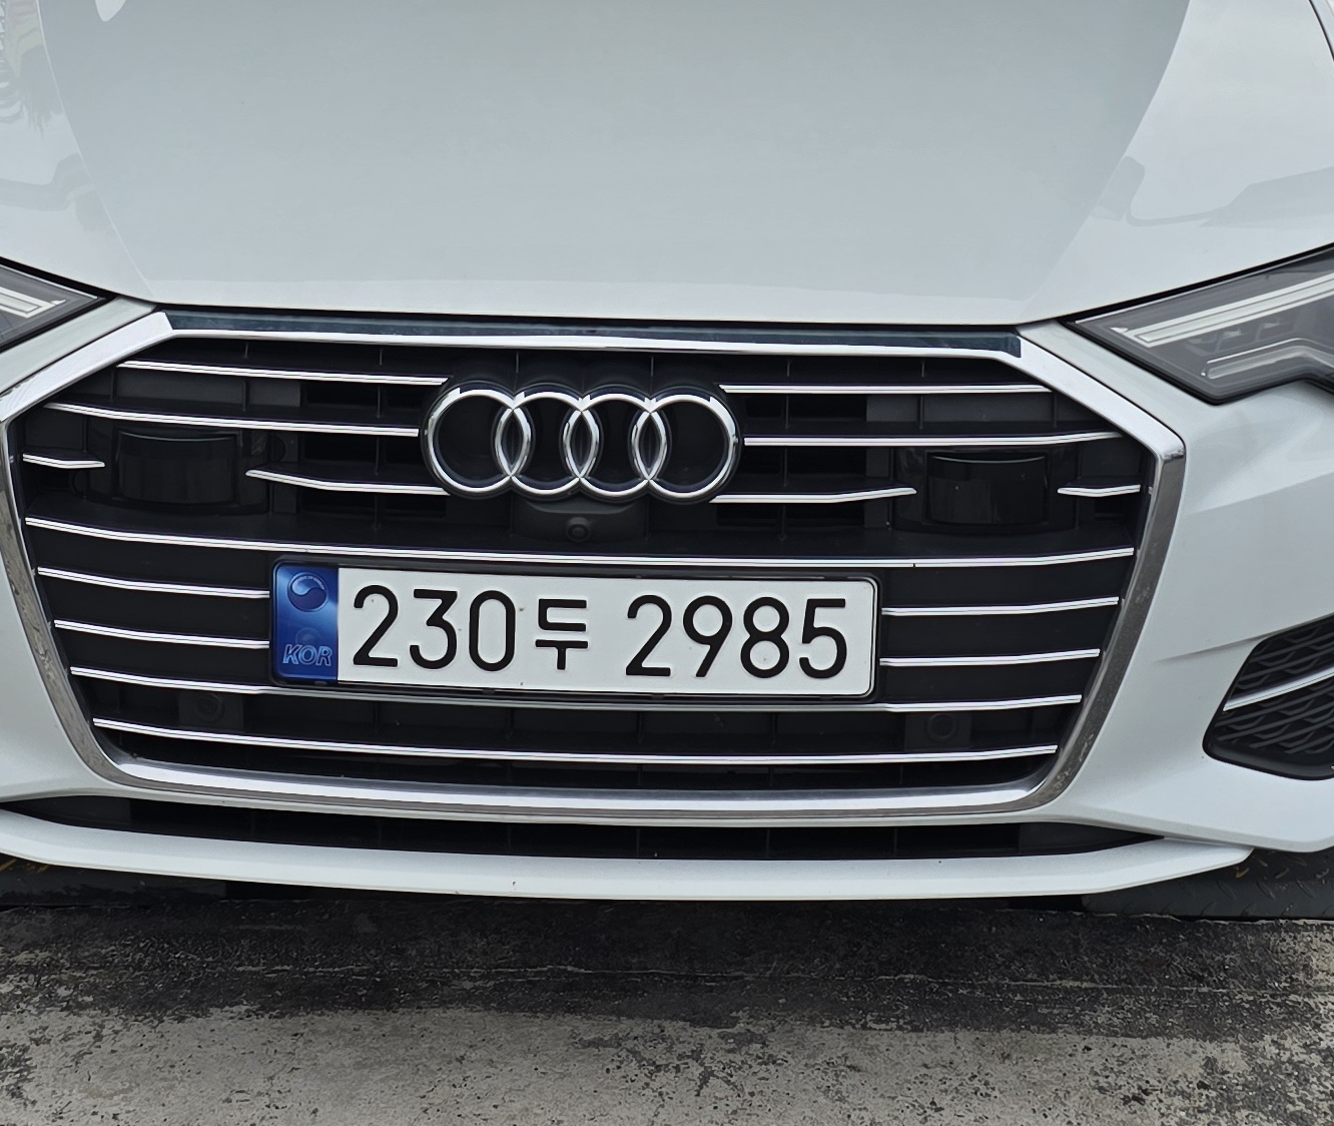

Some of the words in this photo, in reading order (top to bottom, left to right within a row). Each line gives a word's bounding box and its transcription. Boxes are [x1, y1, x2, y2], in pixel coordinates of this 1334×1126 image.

[283, 644, 332, 666] KOR
[353, 584, 589, 673] 230두
[625, 594, 848, 679] 2985
